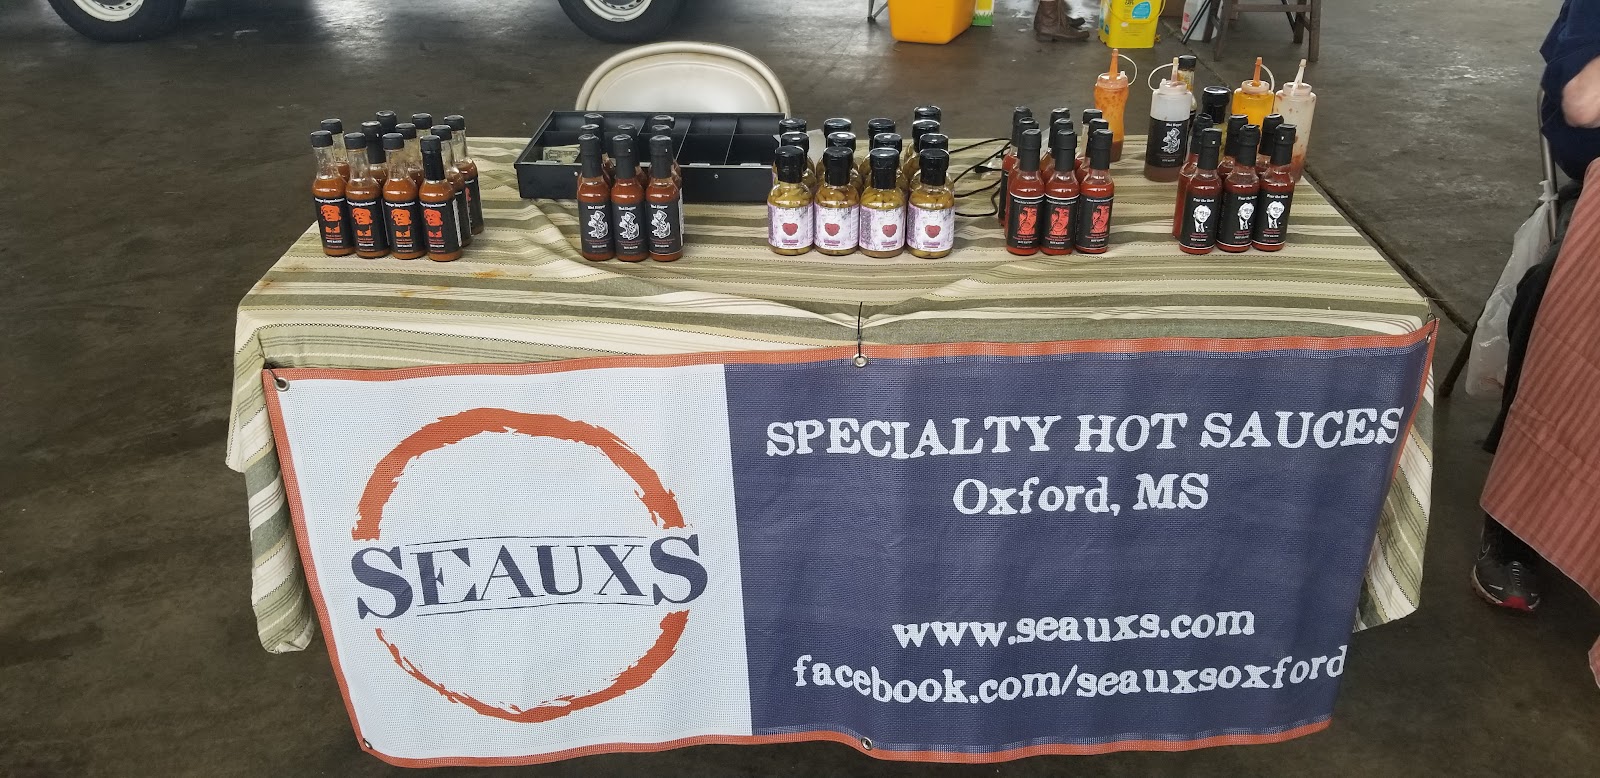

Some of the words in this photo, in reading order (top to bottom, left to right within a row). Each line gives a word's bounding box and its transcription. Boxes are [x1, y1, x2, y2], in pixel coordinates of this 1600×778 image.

[766, 416, 1062, 461] SPECIALTY
[1075, 413, 1188, 454] HOT
[1199, 407, 1405, 450] SAUCES
[952, 476, 1121, 518] Oxford,
[1133, 472, 1210, 512] MS
[351, 534, 709, 621] SEAUXS
[892, 610, 1256, 650] www.seauxs.com
[793, 645, 1349, 705] facebook.com/seauxsoxford
